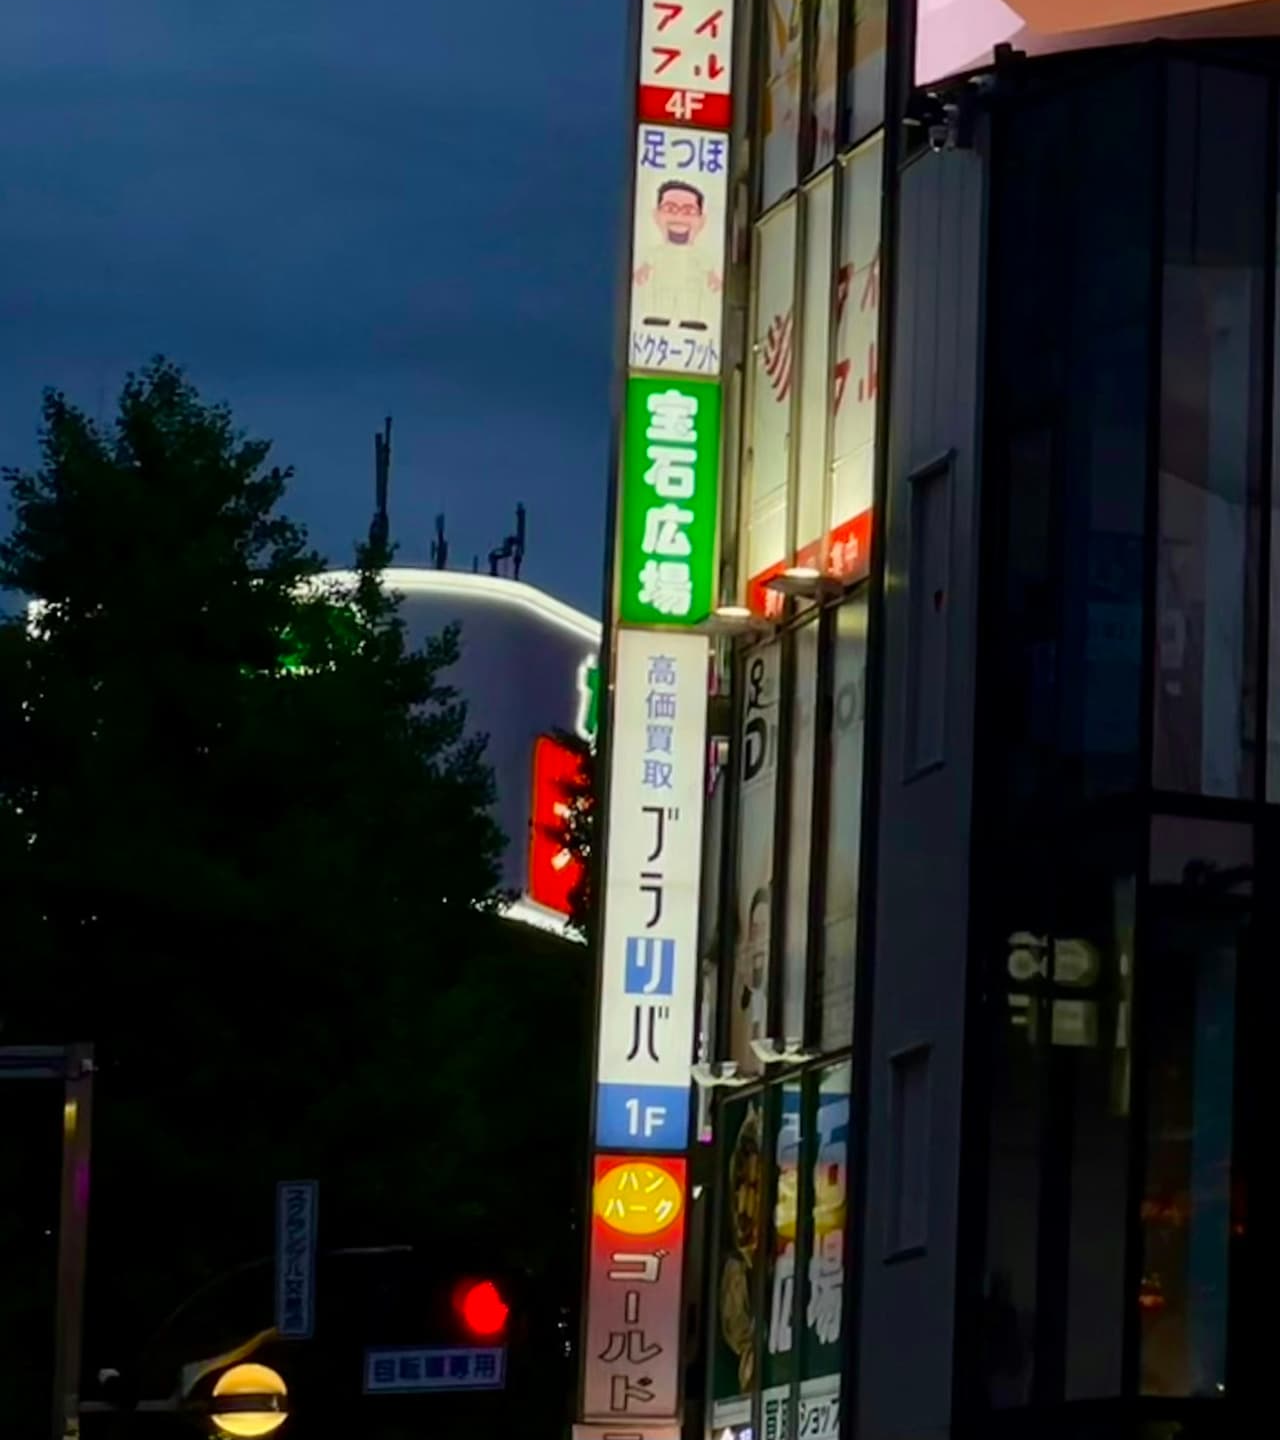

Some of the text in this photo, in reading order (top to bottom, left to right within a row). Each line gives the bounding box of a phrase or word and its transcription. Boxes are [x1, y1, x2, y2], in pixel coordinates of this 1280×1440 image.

[664, 91, 706, 120] 4F
[631, 331, 720, 372] ドクターフット
[637, 388, 699, 617] 宝石広場
[641, 655, 678, 790] 高価買取
[625, 806, 680, 1063] ブラリバ
[625, 1098, 667, 1137] 1F
[598, 1248, 671, 1412] ゴールド
